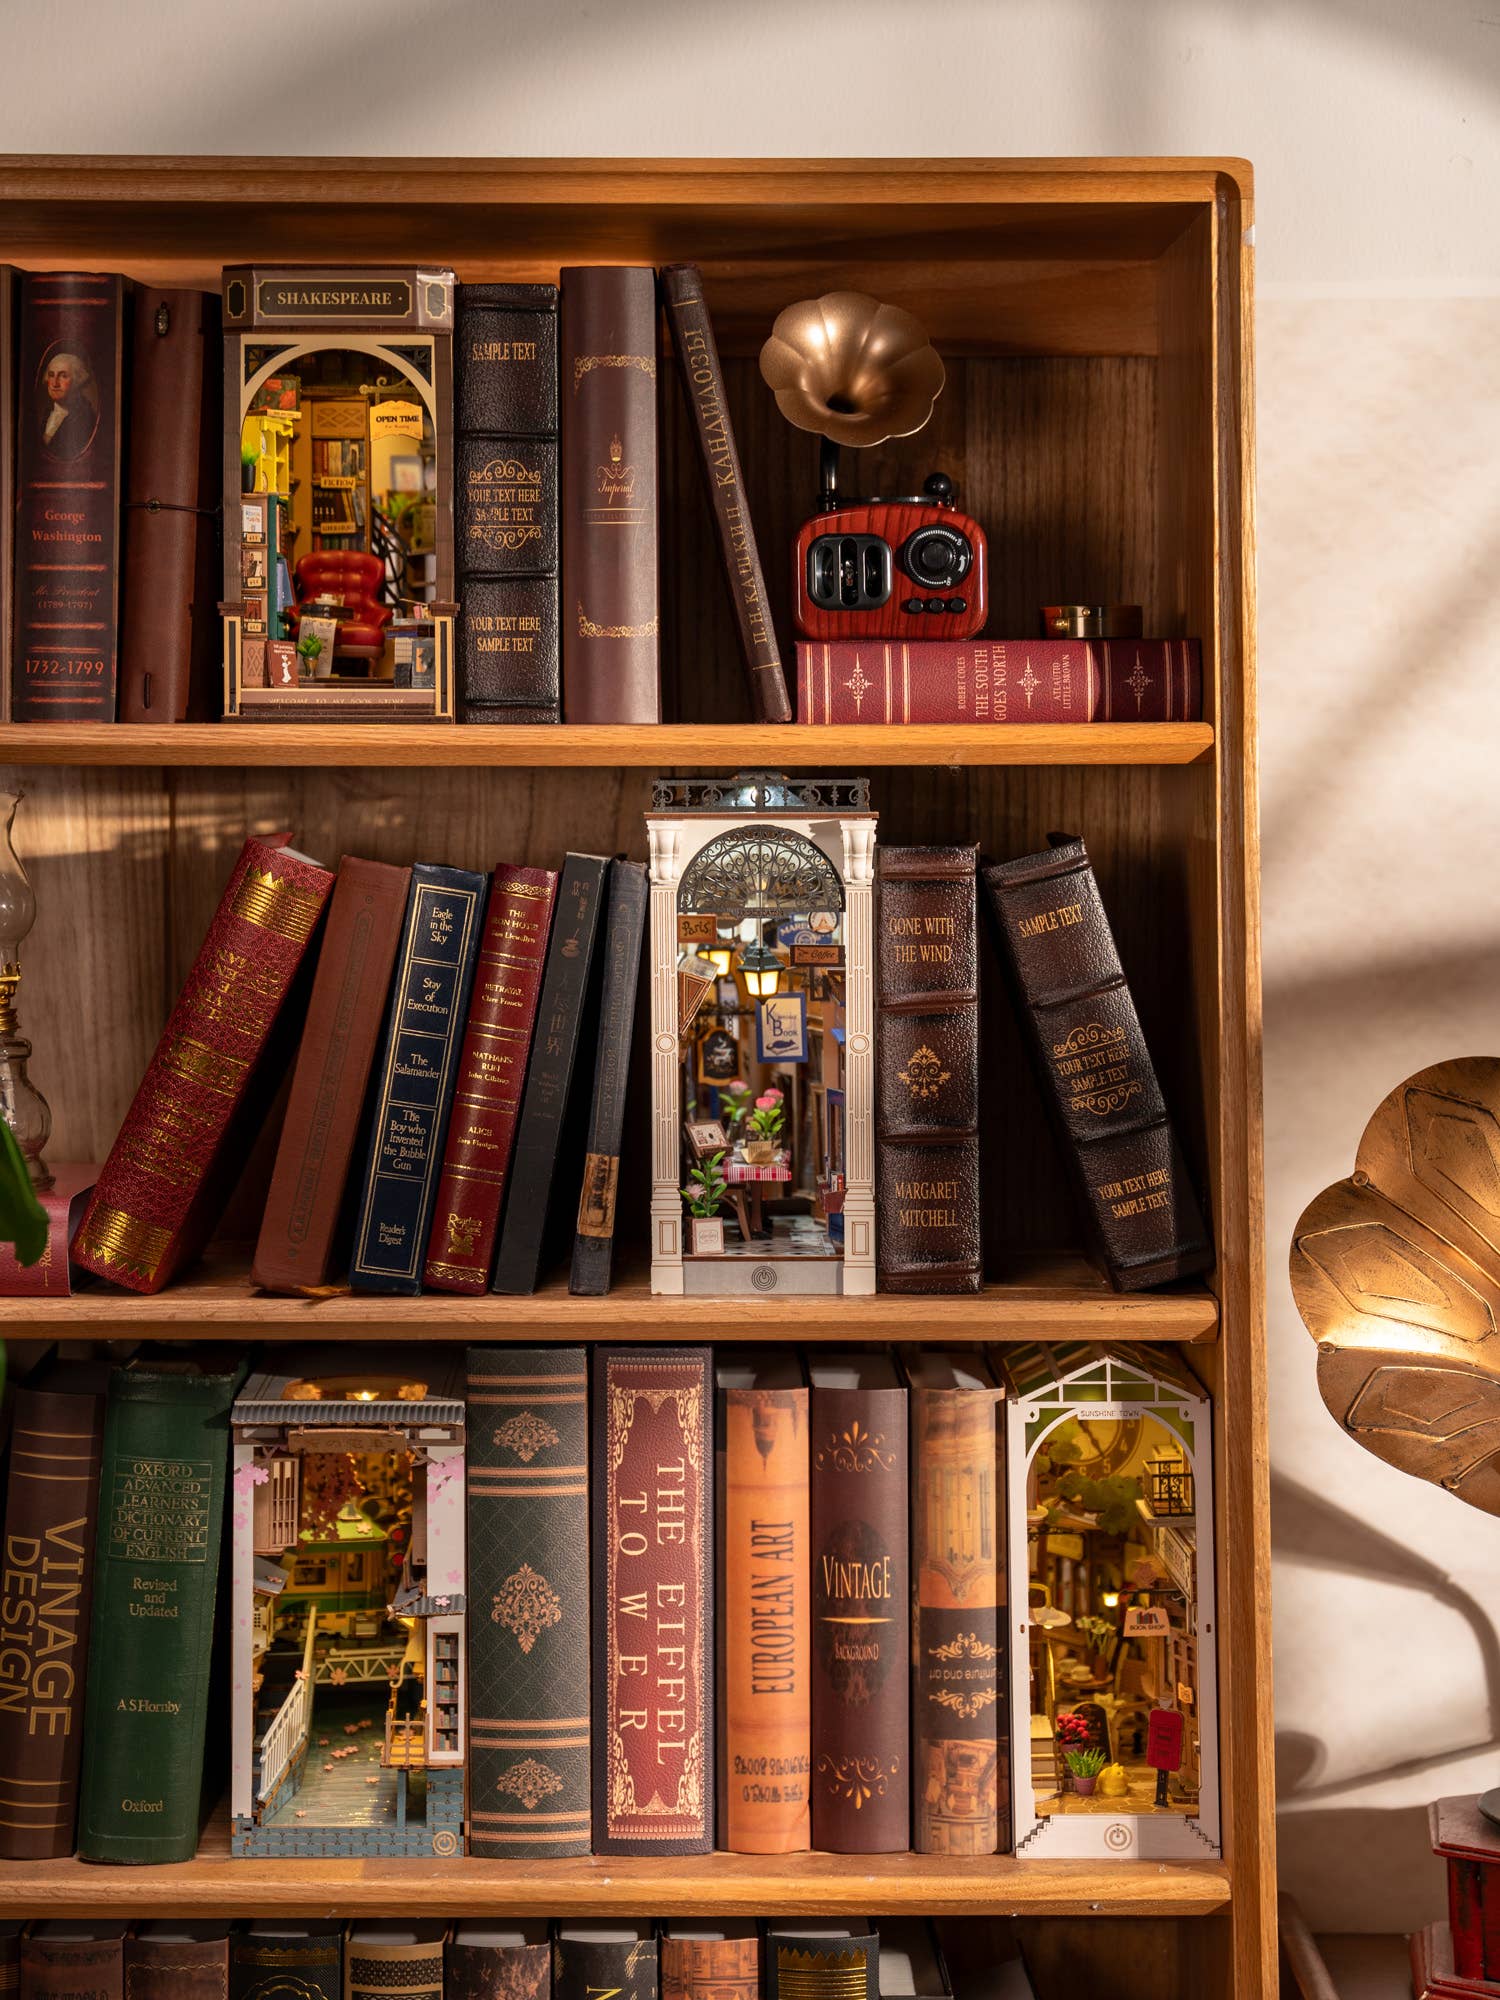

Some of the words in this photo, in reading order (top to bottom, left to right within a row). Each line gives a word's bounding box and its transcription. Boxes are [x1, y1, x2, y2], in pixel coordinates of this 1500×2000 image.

[277, 292, 392, 305] SHAKESPEARE
[472, 342, 509, 361] SAMPLE
[512, 342, 537, 360] TEXT
[684, 327, 737, 489] КАНДИДОЗЫ
[375, 415, 397, 423] OPEN
[399, 415, 420, 423] TIME
[494, 489, 516, 502] TEXT
[518, 489, 541, 502] HERE
[44, 509, 86, 524] George
[511, 508, 534, 521] TEXT
[32, 530, 102, 545] Washington
[470, 616, 493, 631] YOUR
[495, 616, 517, 631] TEXT
[519, 616, 541, 631] HERE
[477, 637, 510, 652] SAMPLE
[512, 637, 533, 652] TEXT
[957, 656, 966, 679] COLES
[974, 649, 989, 690] SOUTH
[992, 645, 1007, 686] NORTH
[975, 693, 989, 717] THE
[993, 690, 1007, 721] GOES
[431, 906, 453, 921] Eagle
[1018, 911, 1058, 939] SAMPLE
[1057, 904, 1085, 928] TEXT
[430, 921, 438, 929] in
[439, 921, 453, 932] the
[889, 917, 921, 935] GONE
[924, 917, 954, 935] WITH
[430, 931, 448, 945] Sky
[894, 945, 917, 963] THE
[919, 945, 951, 963] WIND
[423, 977, 441, 991] Stay
[425, 992, 435, 1002] of
[407, 998, 449, 1015] Execution
[411, 1053, 429, 1067] The
[1107, 1045, 1131, 1066] HERE
[394, 1062, 442, 1080] Salamander
[1070, 1070, 1107, 1093] SAMPLE
[1107, 1065, 1130, 1085] TEXT
[402, 1109, 420, 1122] The
[390, 1120, 408, 1135] Boy
[408, 1124, 427, 1135] who
[389, 1133, 424, 1147] Invented
[384, 1145, 398, 1156] the
[399, 1149, 427, 1161] Bubble
[392, 1159, 412, 1171] Gun
[895, 1180, 961, 1200] MARGARET
[1100, 1180, 1121, 1199] YOUR
[1120, 1175, 1145, 1195] TEXT
[1145, 1168, 1169, 1188] HERE
[1111, 1198, 1146, 1220] SAMPLE
[1145, 1192, 1169, 1212] TEXT
[899, 1208, 960, 1227] MITCHELL
[378, 1234, 403, 1246] Digest
[133, 1463, 193, 1478] OXFORD
[124, 1479, 201, 1494] ADVANCED
[656, 1456, 686, 1545] THE
[118, 1510, 202, 1527] DICTIONARY
[113, 1527, 130, 1541] OF
[133, 1528, 203, 1543] CURRENT
[751, 1519, 796, 1562] ART
[126, 1544, 188, 1560] ENGLISH
[133, 1577, 177, 1591] Revised
[823, 1554, 892, 1599] VINTAGE
[144, 1592, 166, 1603] and
[129, 1603, 178, 1617] Updated
[619, 1491, 649, 1731] TOWER
[0, 1535, 42, 1714] DESIGN
[28, 1516, 88, 1736] VINAGE
[751, 1569, 795, 1696] EUROPEAN
[1129, 1623, 1146, 1631] BOOK
[834, 1641, 880, 1661] BACKGROUND
[656, 1581, 686, 1765] EIFFEL
[943, 1669, 962, 1681] and
[138, 1699, 181, 1715] Hornby
[121, 1799, 164, 1814] Oxford
